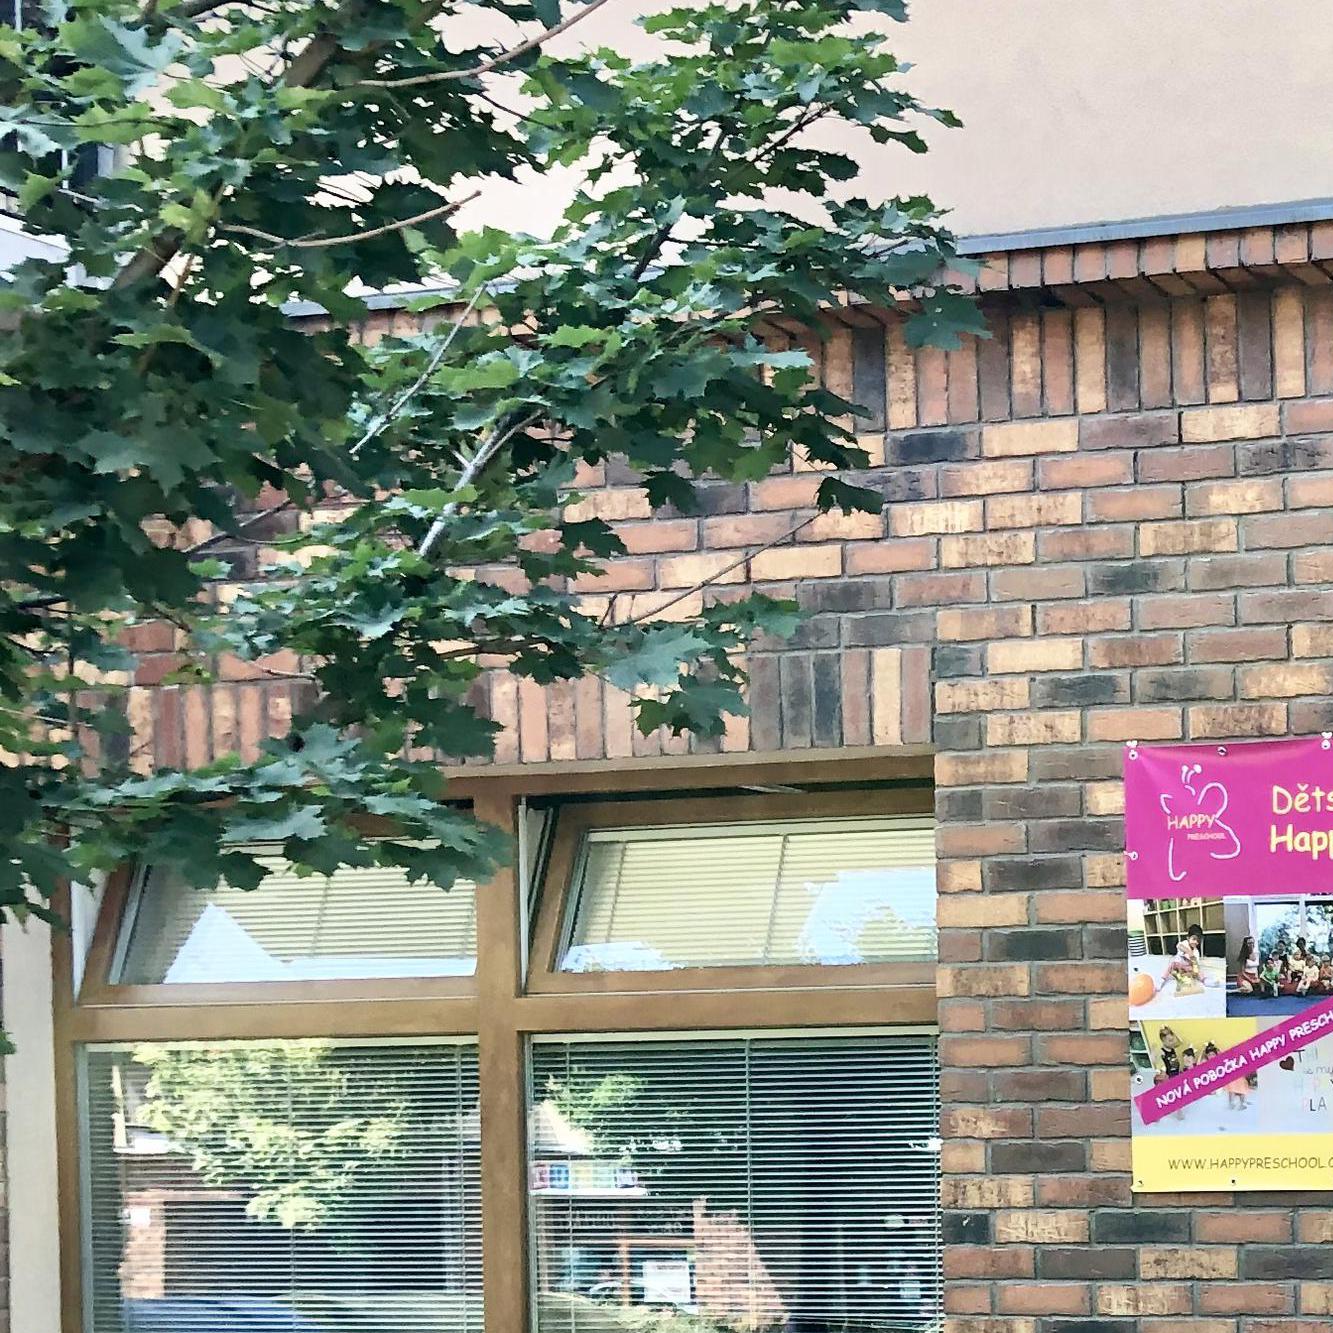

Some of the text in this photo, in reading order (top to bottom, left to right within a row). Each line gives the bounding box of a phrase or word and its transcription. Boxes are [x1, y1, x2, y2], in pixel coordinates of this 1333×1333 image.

[1167, 813, 1216, 831] HAPPY
[1156, 1080, 1192, 1109] NOVÁ
[1194, 1055, 1248, 1090] POBOČKA
[1249, 1033, 1287, 1061] HAPPY
